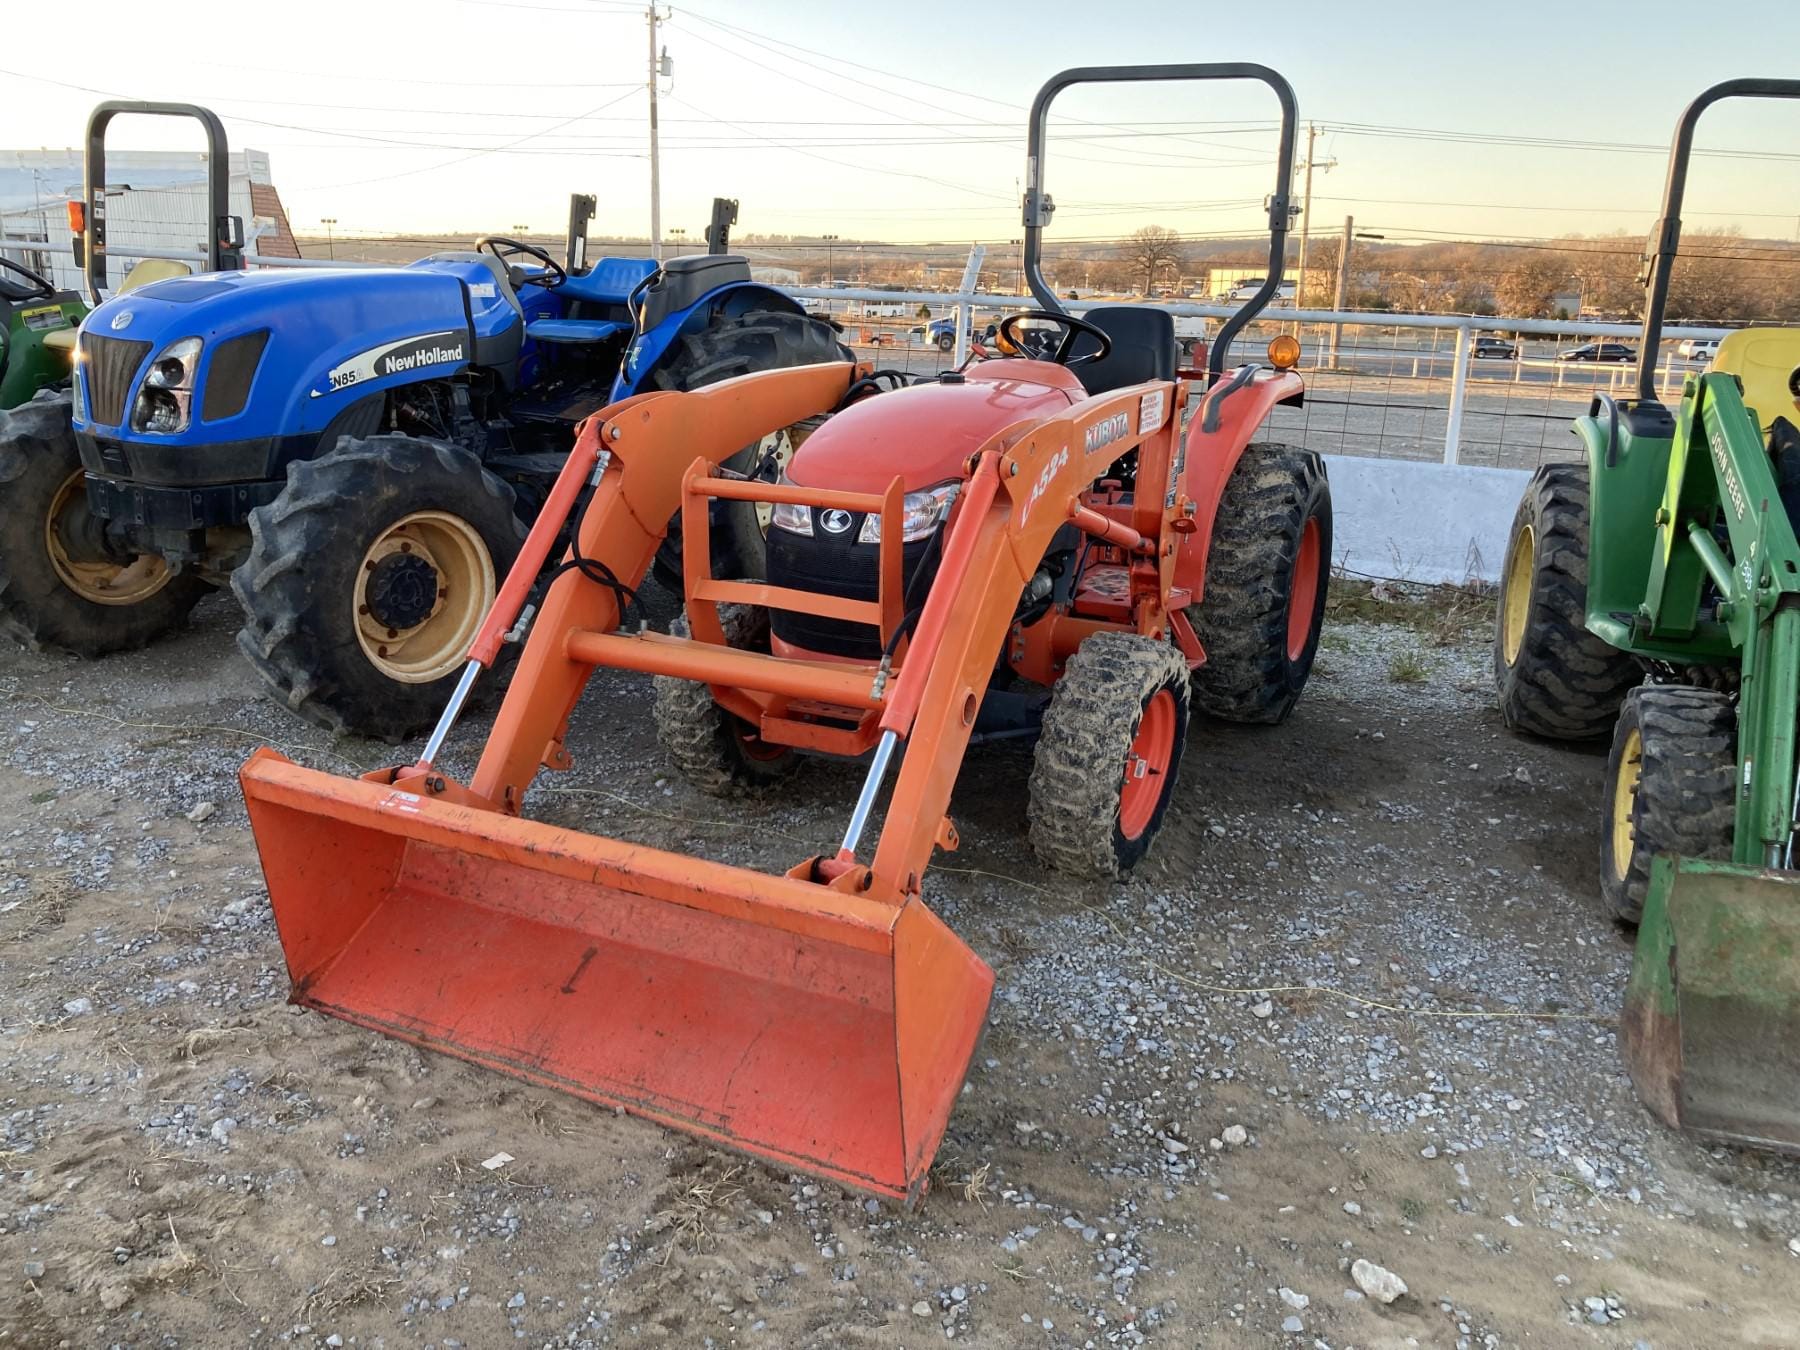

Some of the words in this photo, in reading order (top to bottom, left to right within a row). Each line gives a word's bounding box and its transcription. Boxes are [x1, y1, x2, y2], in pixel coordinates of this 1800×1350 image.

[386, 355, 416, 374] New
[416, 344, 463, 367] Holland
[1085, 412, 1129, 455] KUBOTA
[1021, 445, 1069, 528] LA524
[1711, 431, 1728, 473] JOHN
[1726, 466, 1745, 522] DEERE
